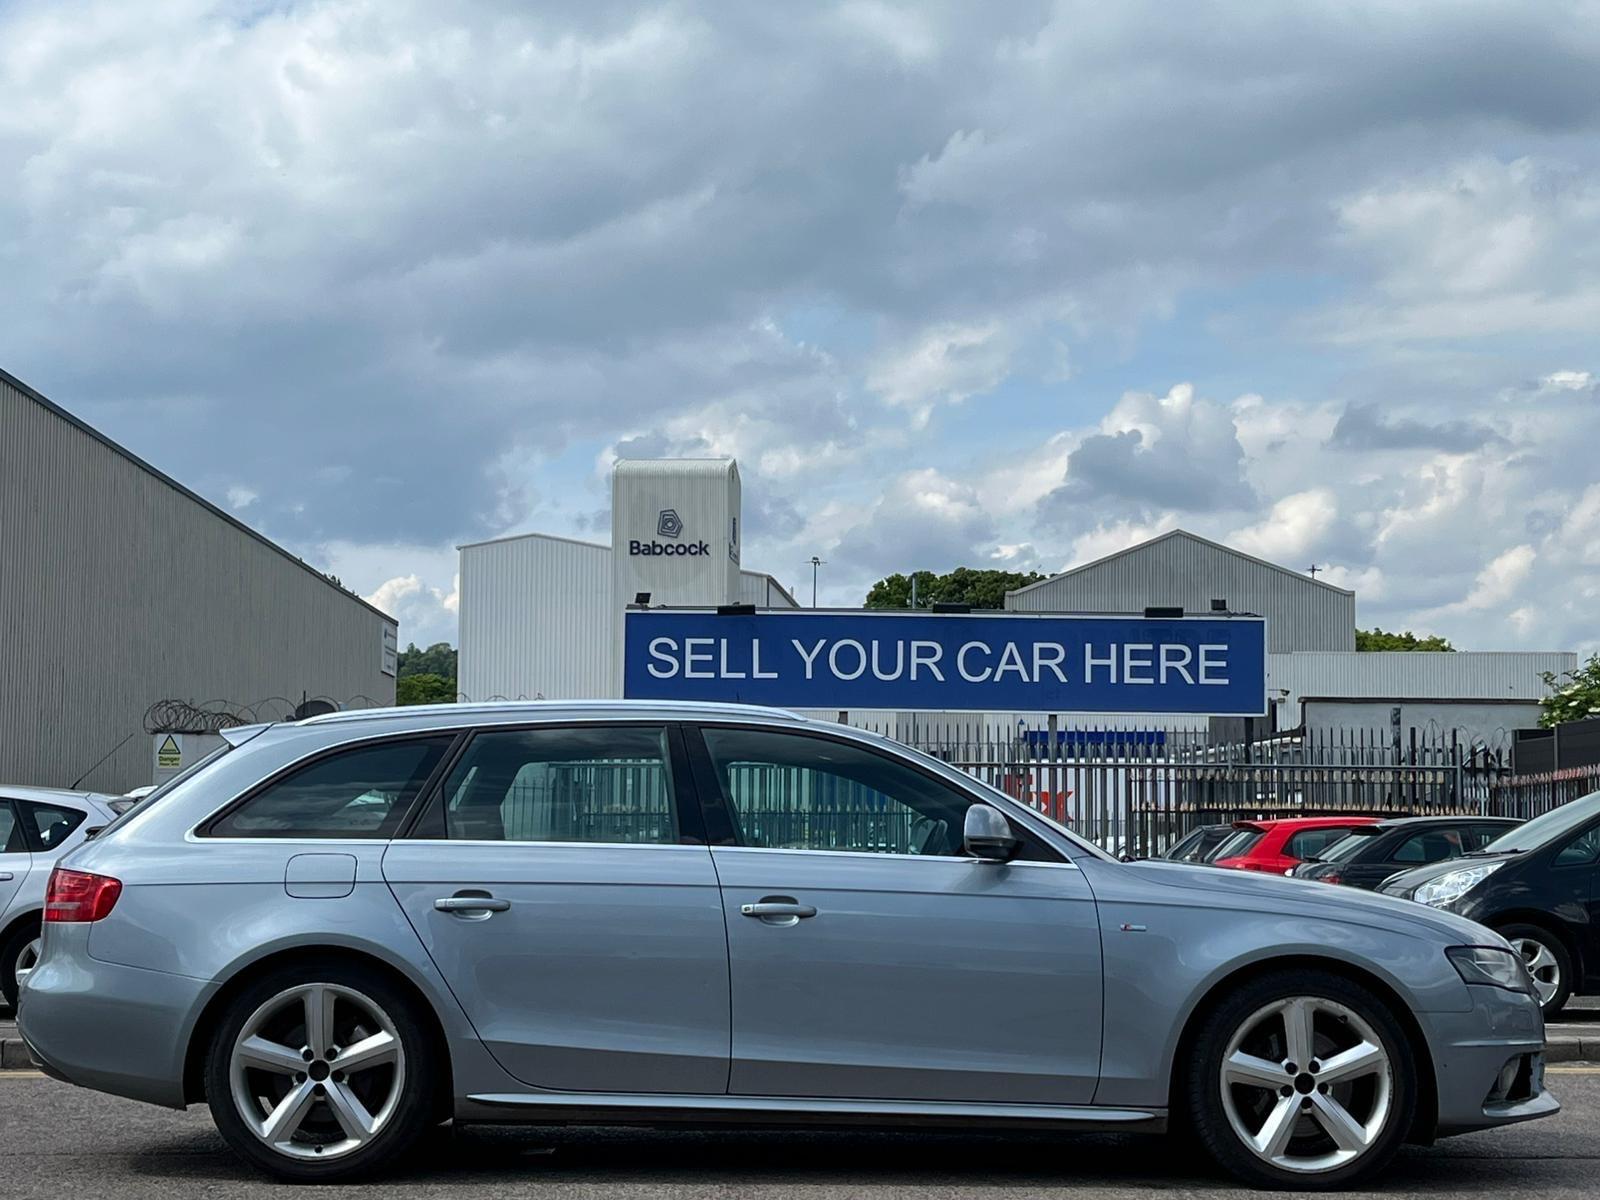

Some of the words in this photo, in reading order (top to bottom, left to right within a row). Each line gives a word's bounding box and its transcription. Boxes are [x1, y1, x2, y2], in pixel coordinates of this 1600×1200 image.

[630, 540, 709, 556] Babcock
[648, 638, 777, 678] SELL
[792, 640, 944, 681] YOUR
[958, 642, 1067, 682] CAR
[1086, 644, 1228, 684] HERE
